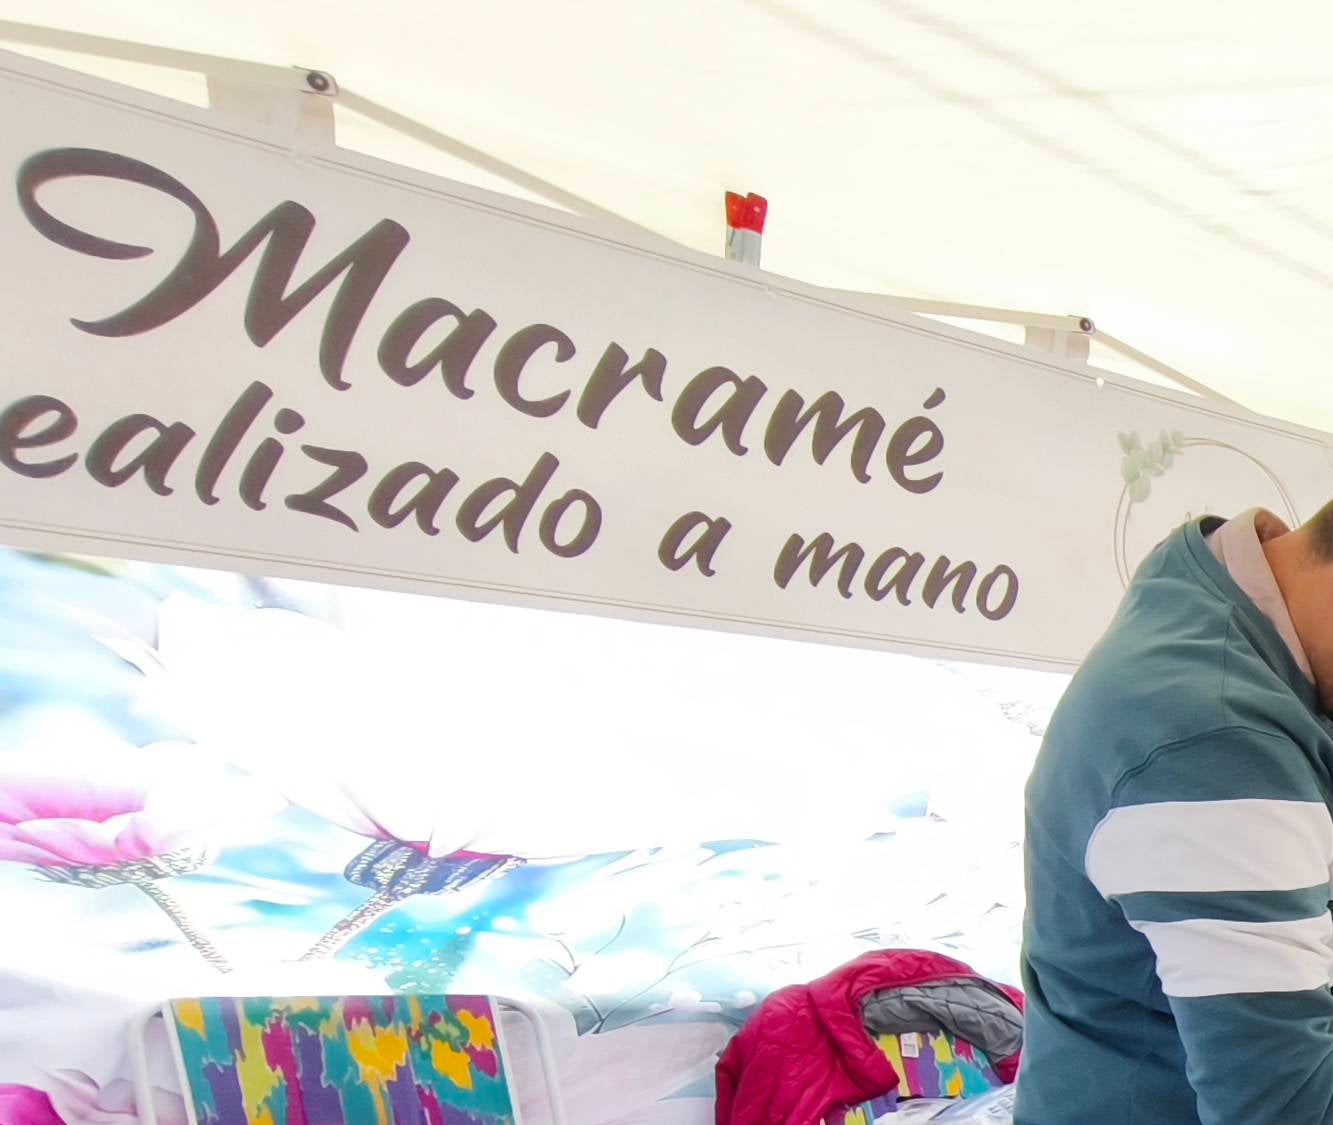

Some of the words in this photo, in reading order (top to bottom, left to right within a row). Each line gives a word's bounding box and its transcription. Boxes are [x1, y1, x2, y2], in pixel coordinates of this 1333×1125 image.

[16, 146, 946, 494] Macramé
[0, 380, 603, 559] ealizado
[657, 511, 732, 578] a
[773, 532, 1019, 621] mano
